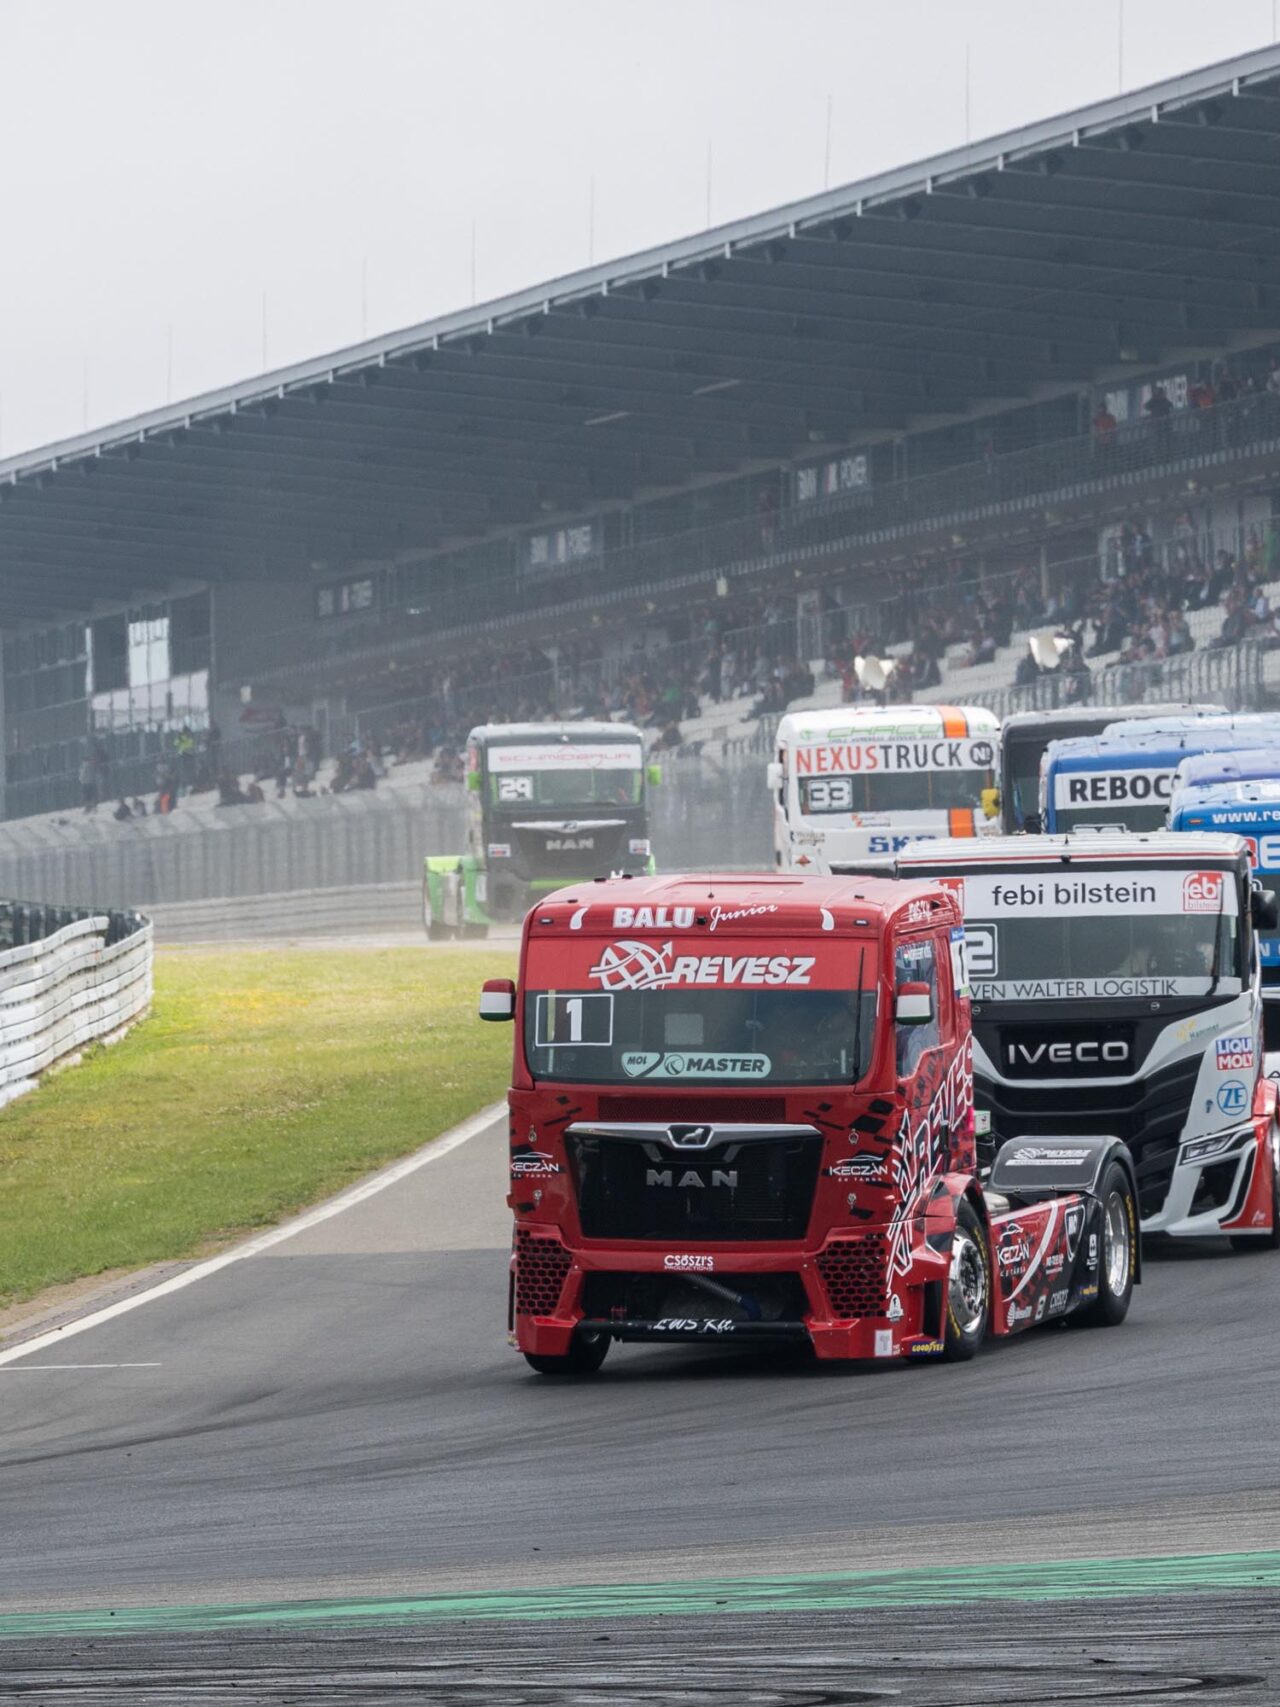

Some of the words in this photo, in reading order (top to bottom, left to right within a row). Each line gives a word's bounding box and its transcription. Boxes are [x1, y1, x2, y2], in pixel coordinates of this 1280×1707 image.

[796, 743, 962, 773] NEXUSTRUCK
[501, 778, 531, 798] 29
[811, 781, 850, 808] 33
[1069, 774, 1181, 803] REBOC
[546, 838, 594, 850] MAN
[868, 835, 937, 853] SK
[992, 884, 1044, 906] febi
[1054, 882, 1156, 906] bilstein
[612, 906, 696, 929] BALU
[708, 903, 779, 931] Junior
[1013, 981, 1087, 998] WALTER
[1094, 979, 1179, 997] LOGISTIK
[565, 998, 583, 1042] 1
[1008, 1041, 1129, 1064] IVECO
[1217, 1038, 1252, 1054] LIQU
[627, 1056, 648, 1066] MOL
[686, 1057, 764, 1073] MASTER
[1218, 1053, 1253, 1070] MOLY
[1219, 1087, 1246, 1108] ZF
[646, 1169, 738, 1188] MAN
